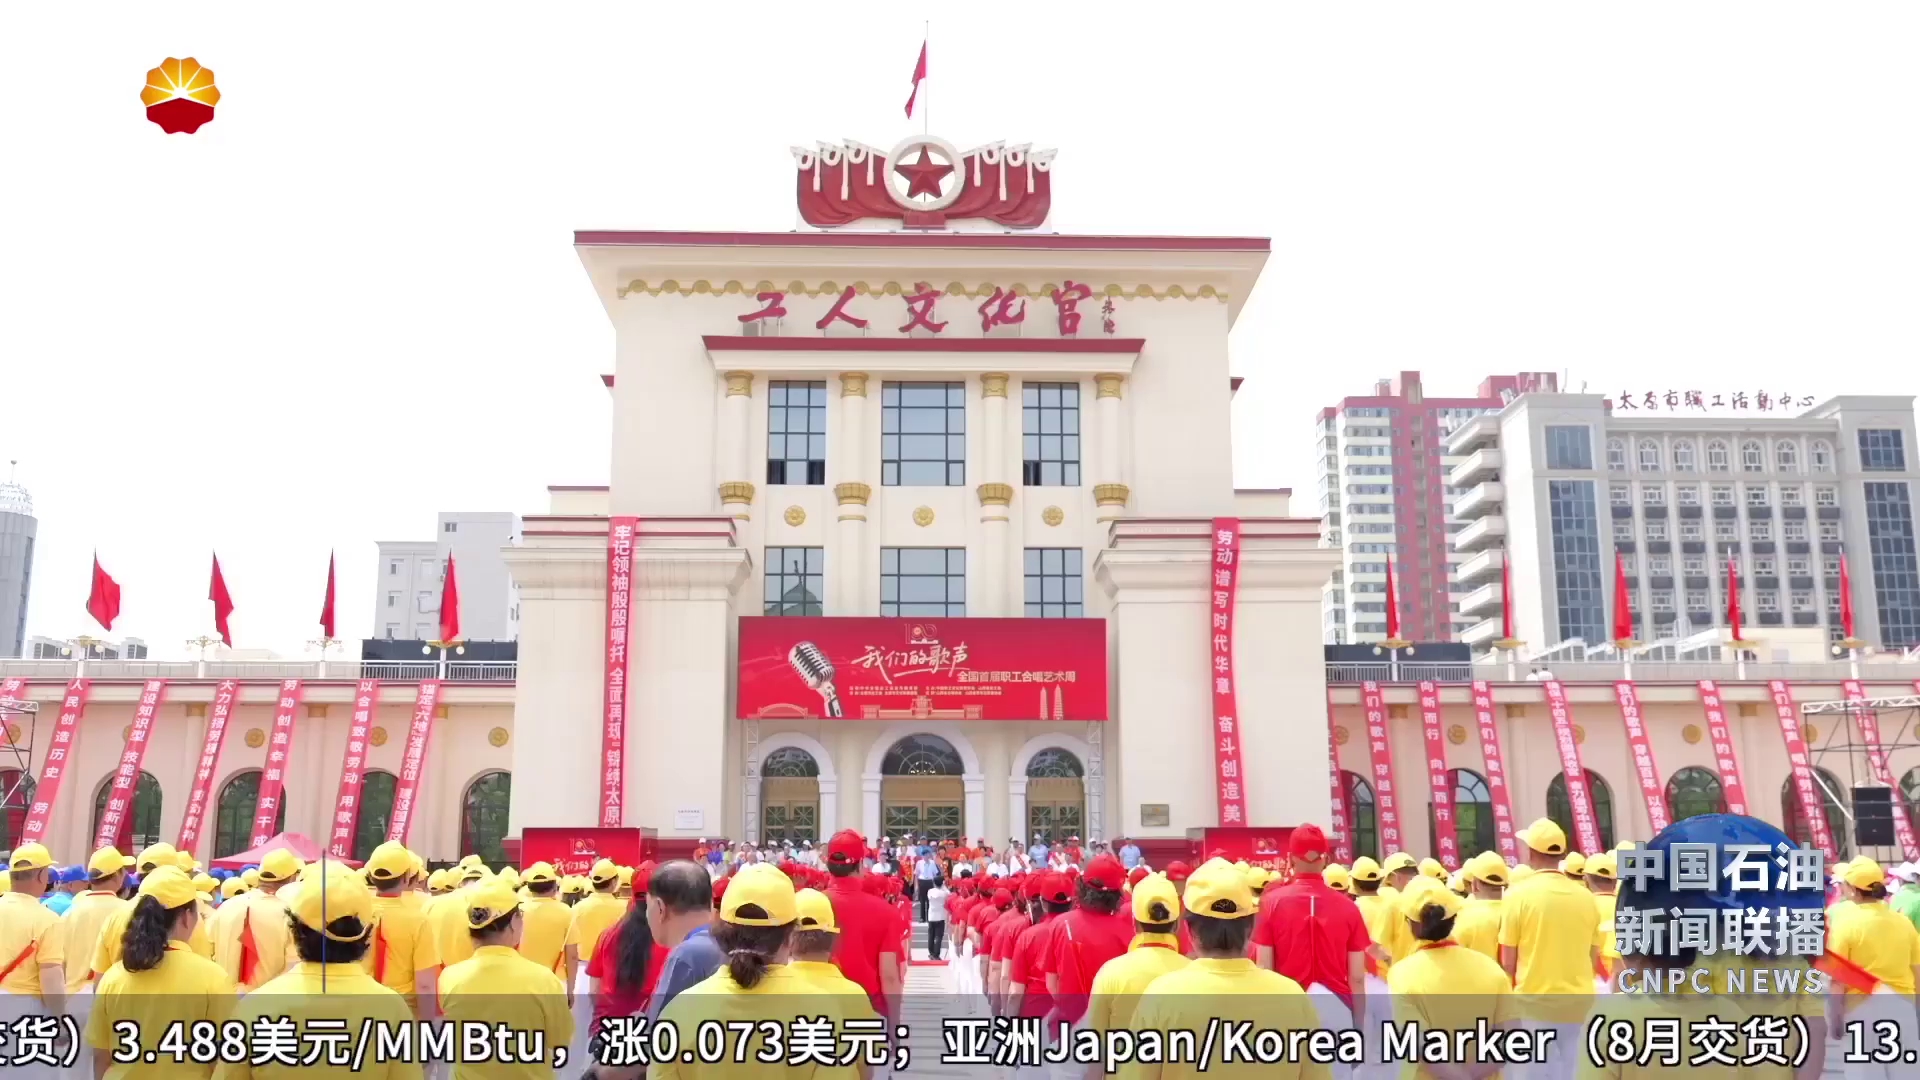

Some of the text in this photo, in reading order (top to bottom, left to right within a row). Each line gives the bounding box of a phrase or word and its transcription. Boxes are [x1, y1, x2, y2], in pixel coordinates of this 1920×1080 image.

[737, 280, 1093, 336] 工人文化宫
[1213, 530, 1233, 694] 劳动谱写时代华章
[850, 641, 970, 684] 我们的歌声
[957, 671, 1077, 684] 全国首届职工合唱艺术周
[44, 680, 83, 778] 人民创造历史
[130, 680, 161, 742] 建设知识型
[266, 680, 299, 781] 劳动创造幸福
[344, 681, 373, 784] 以合唱致敬劳动
[1364, 681, 1384, 753] 我们的歌声
[1421, 681, 1440, 740] 向新而行
[1616, 684, 1643, 738] 我们的歌声
[1700, 680, 1737, 786] 唱响我们的歌声
[115, 751, 139, 789] 技能型
